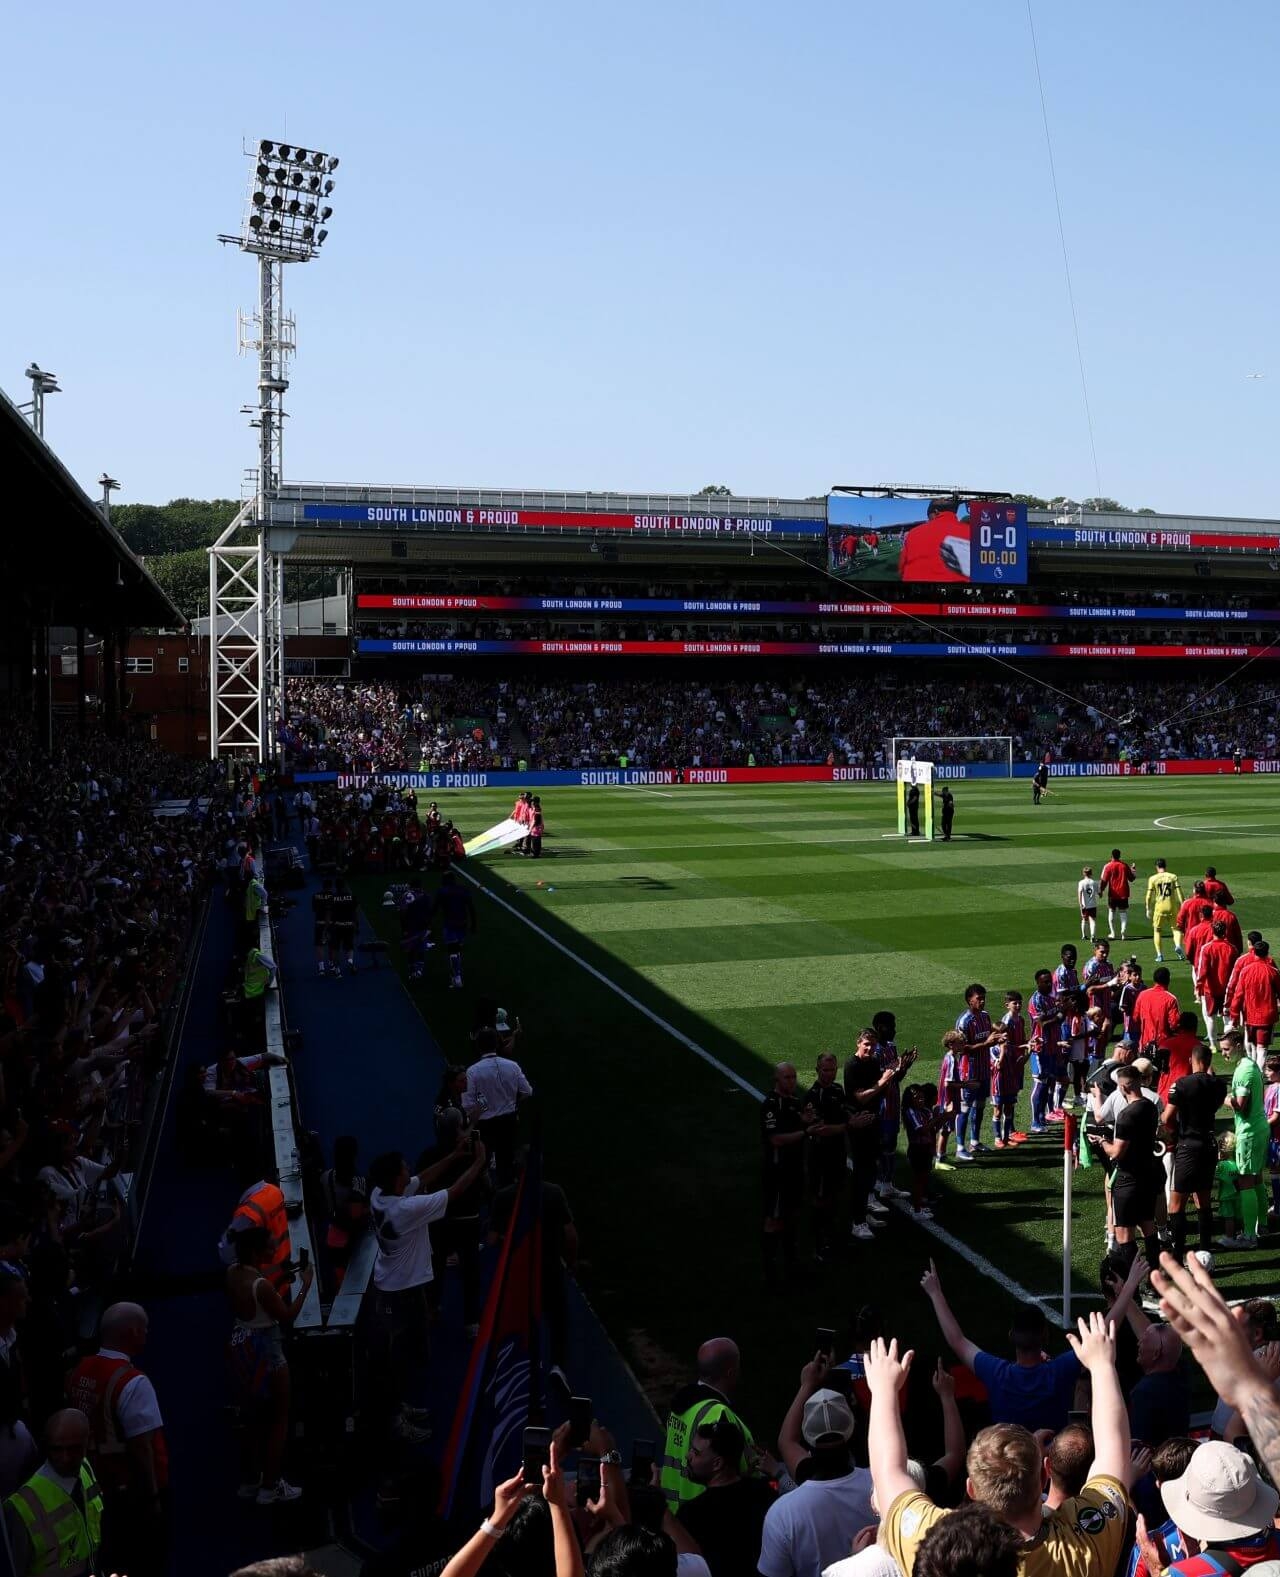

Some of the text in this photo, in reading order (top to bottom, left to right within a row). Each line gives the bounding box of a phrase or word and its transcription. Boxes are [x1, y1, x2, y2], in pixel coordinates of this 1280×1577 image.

[367, 507, 518, 524] SOUTH LONDON & PROUD
[634, 516, 772, 532] SOUTH LONDON & PROUD
[980, 526, 1016, 548] 0-0
[1074, 530, 1191, 546] SOUTH LONDON & PROUD
[980, 550, 1016, 564] 00:00
[392, 598, 414, 606] SOUTH
[542, 600, 563, 608] SOUTH
[684, 602, 704, 610] SOUTH
[690, 770, 727, 782] PROUD
[832, 768, 868, 780] SOUTH
[1080, 762, 1120, 776] LONDON
[1124, 762, 1130, 775] &
[432, 774, 440, 787] &
[446, 774, 487, 787] PROUD
[581, 771, 672, 785] SOUTH LONDON
